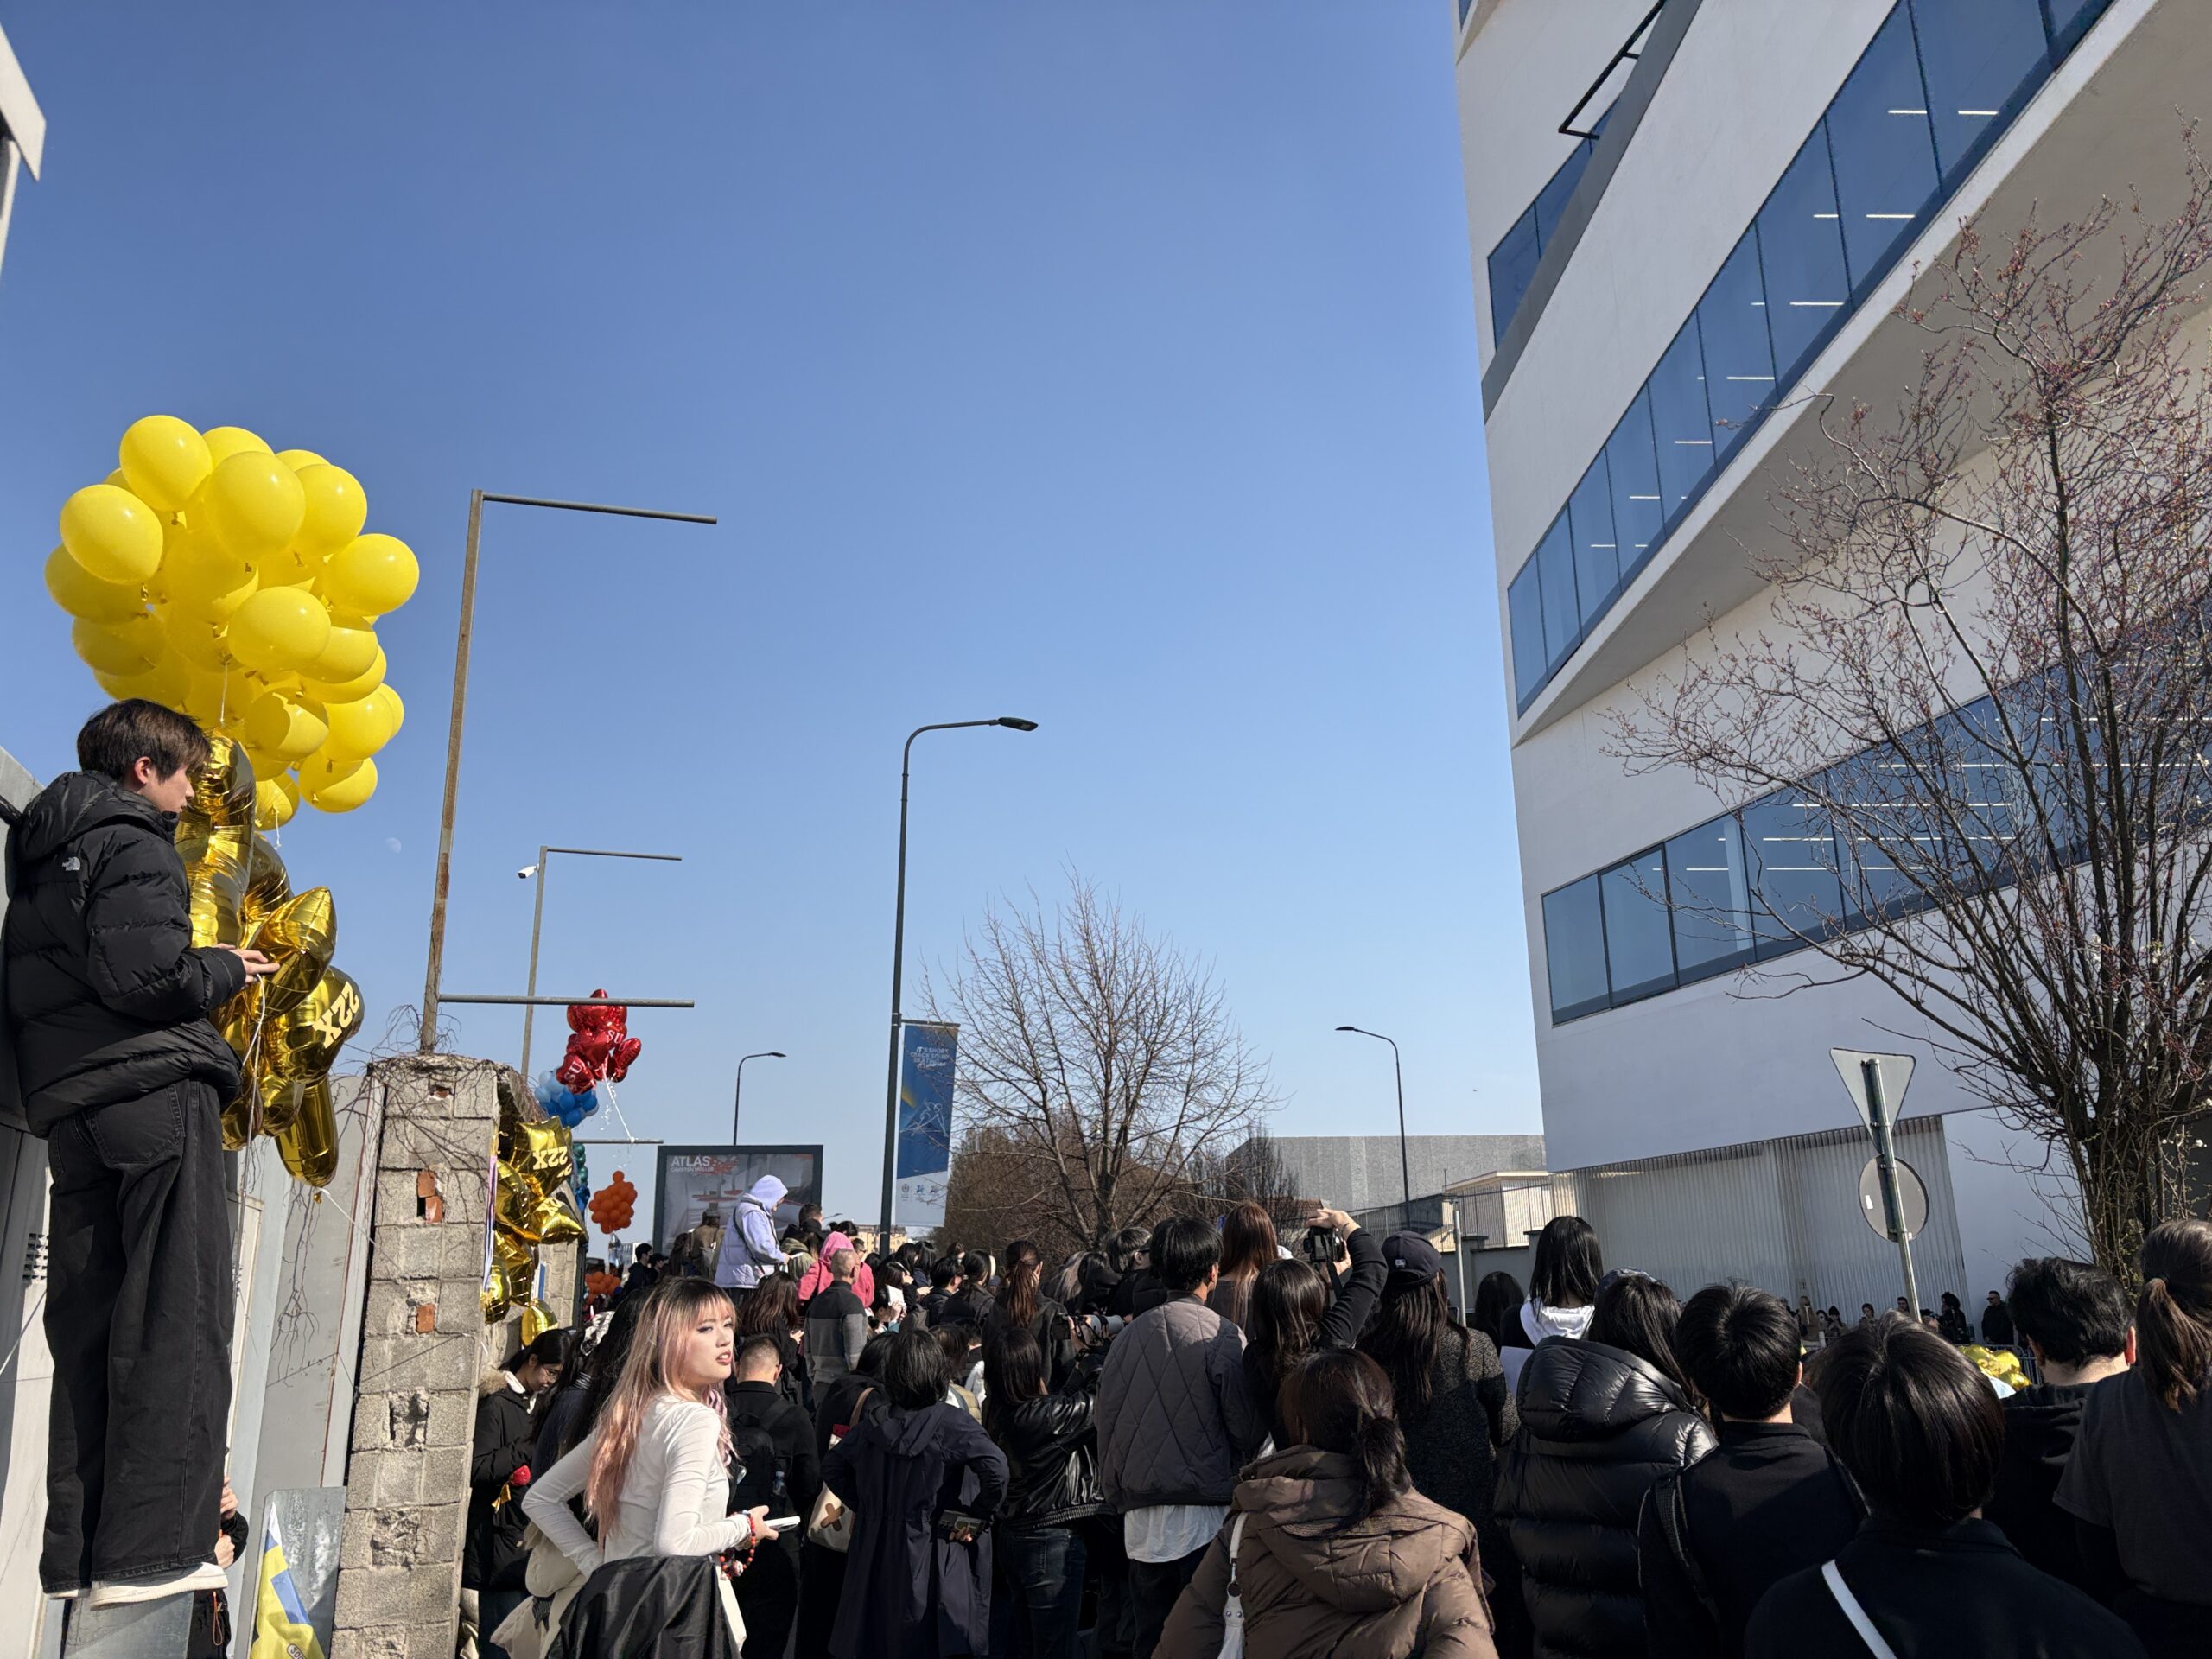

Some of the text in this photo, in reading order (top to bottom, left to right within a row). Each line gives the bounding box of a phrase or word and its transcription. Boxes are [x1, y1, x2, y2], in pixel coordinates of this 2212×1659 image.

[312, 981, 360, 1049] 22X
[532, 1146, 569, 1170] 22X
[671, 1155, 711, 1166] ATLAS
